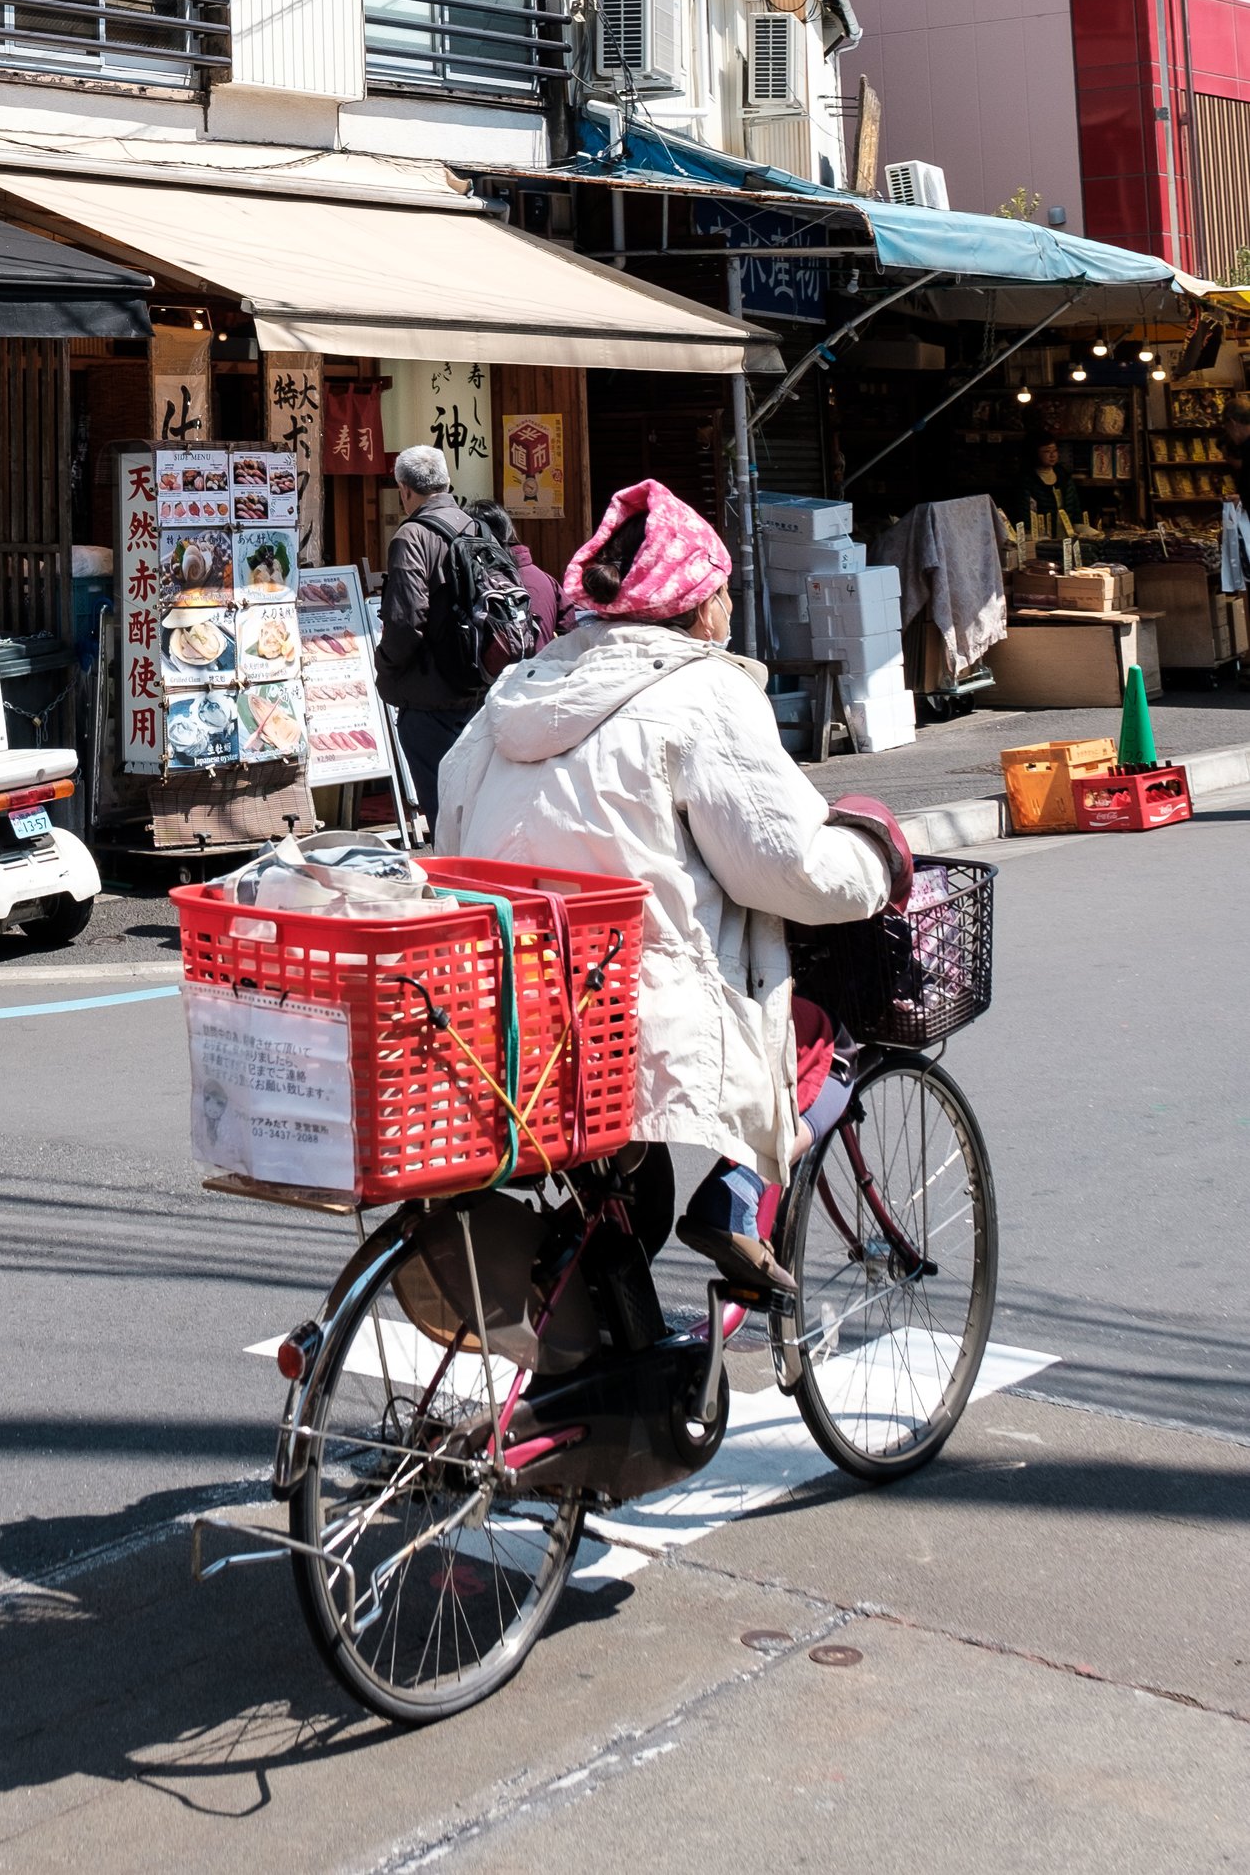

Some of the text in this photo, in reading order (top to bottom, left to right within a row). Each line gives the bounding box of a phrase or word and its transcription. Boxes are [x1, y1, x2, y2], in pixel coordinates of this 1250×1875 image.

[332, 424, 375, 463] 寿司
[174, 453, 212, 462] SIDE MENU
[126, 464, 159, 749] 天然赤酢使用
[194, 754, 239, 767] Japanese oyster
[22, 817, 48, 835] 13-57
